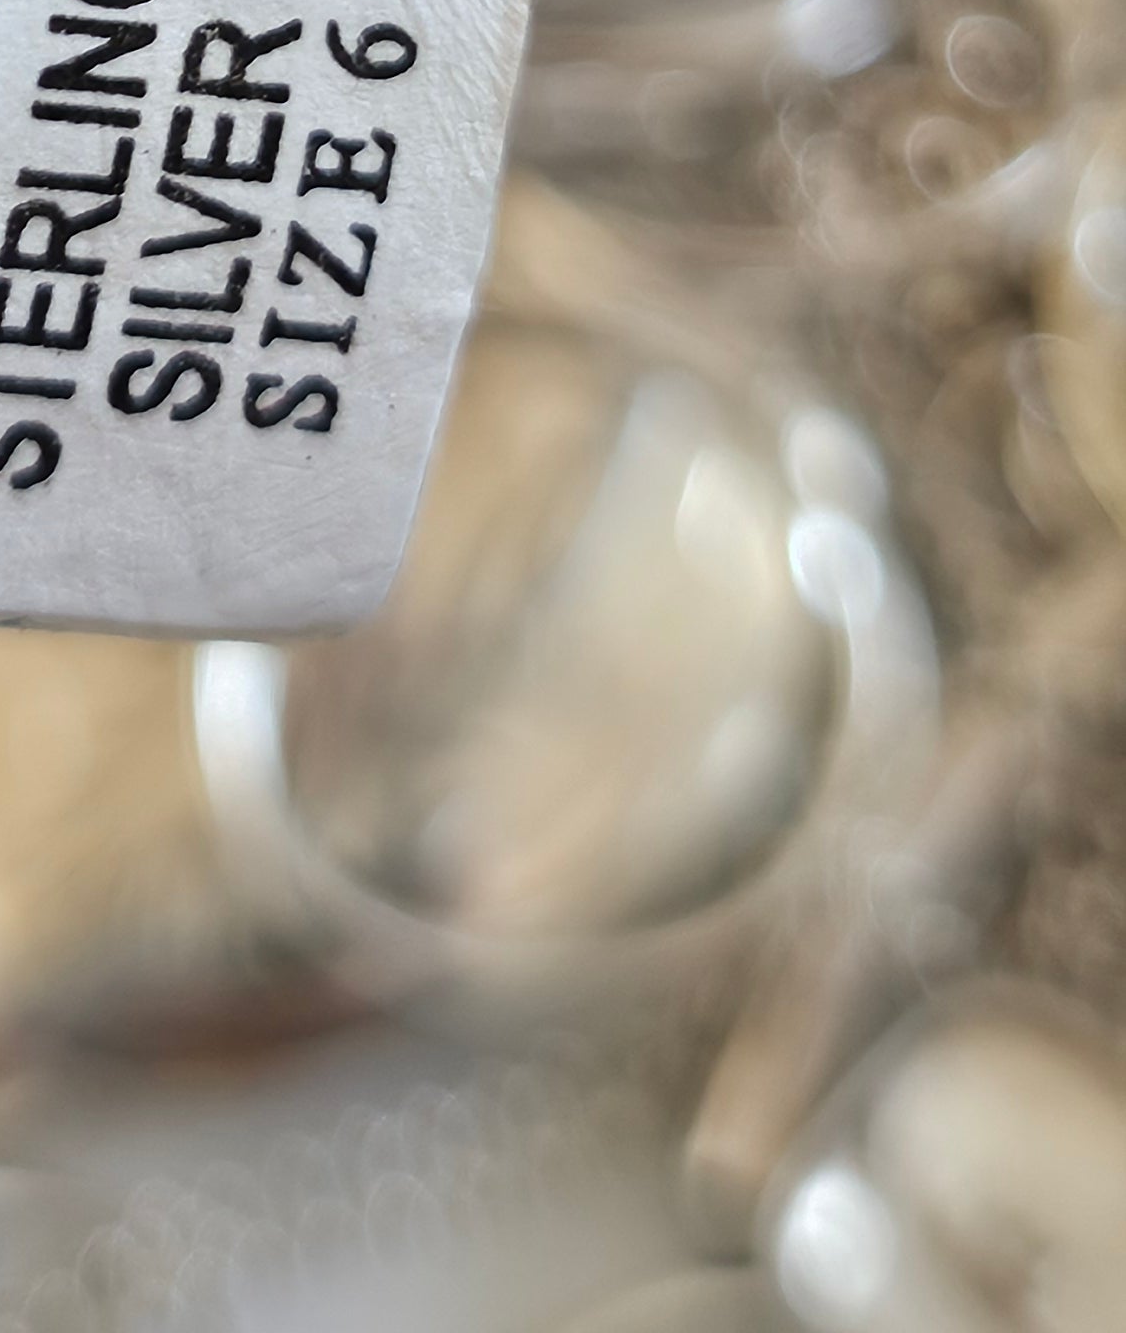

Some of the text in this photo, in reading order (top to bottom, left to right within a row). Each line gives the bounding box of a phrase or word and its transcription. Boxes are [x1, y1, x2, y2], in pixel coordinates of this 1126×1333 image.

[107, 17, 303, 423] SILVER
[243, 18, 419, 433] SIZE 6
